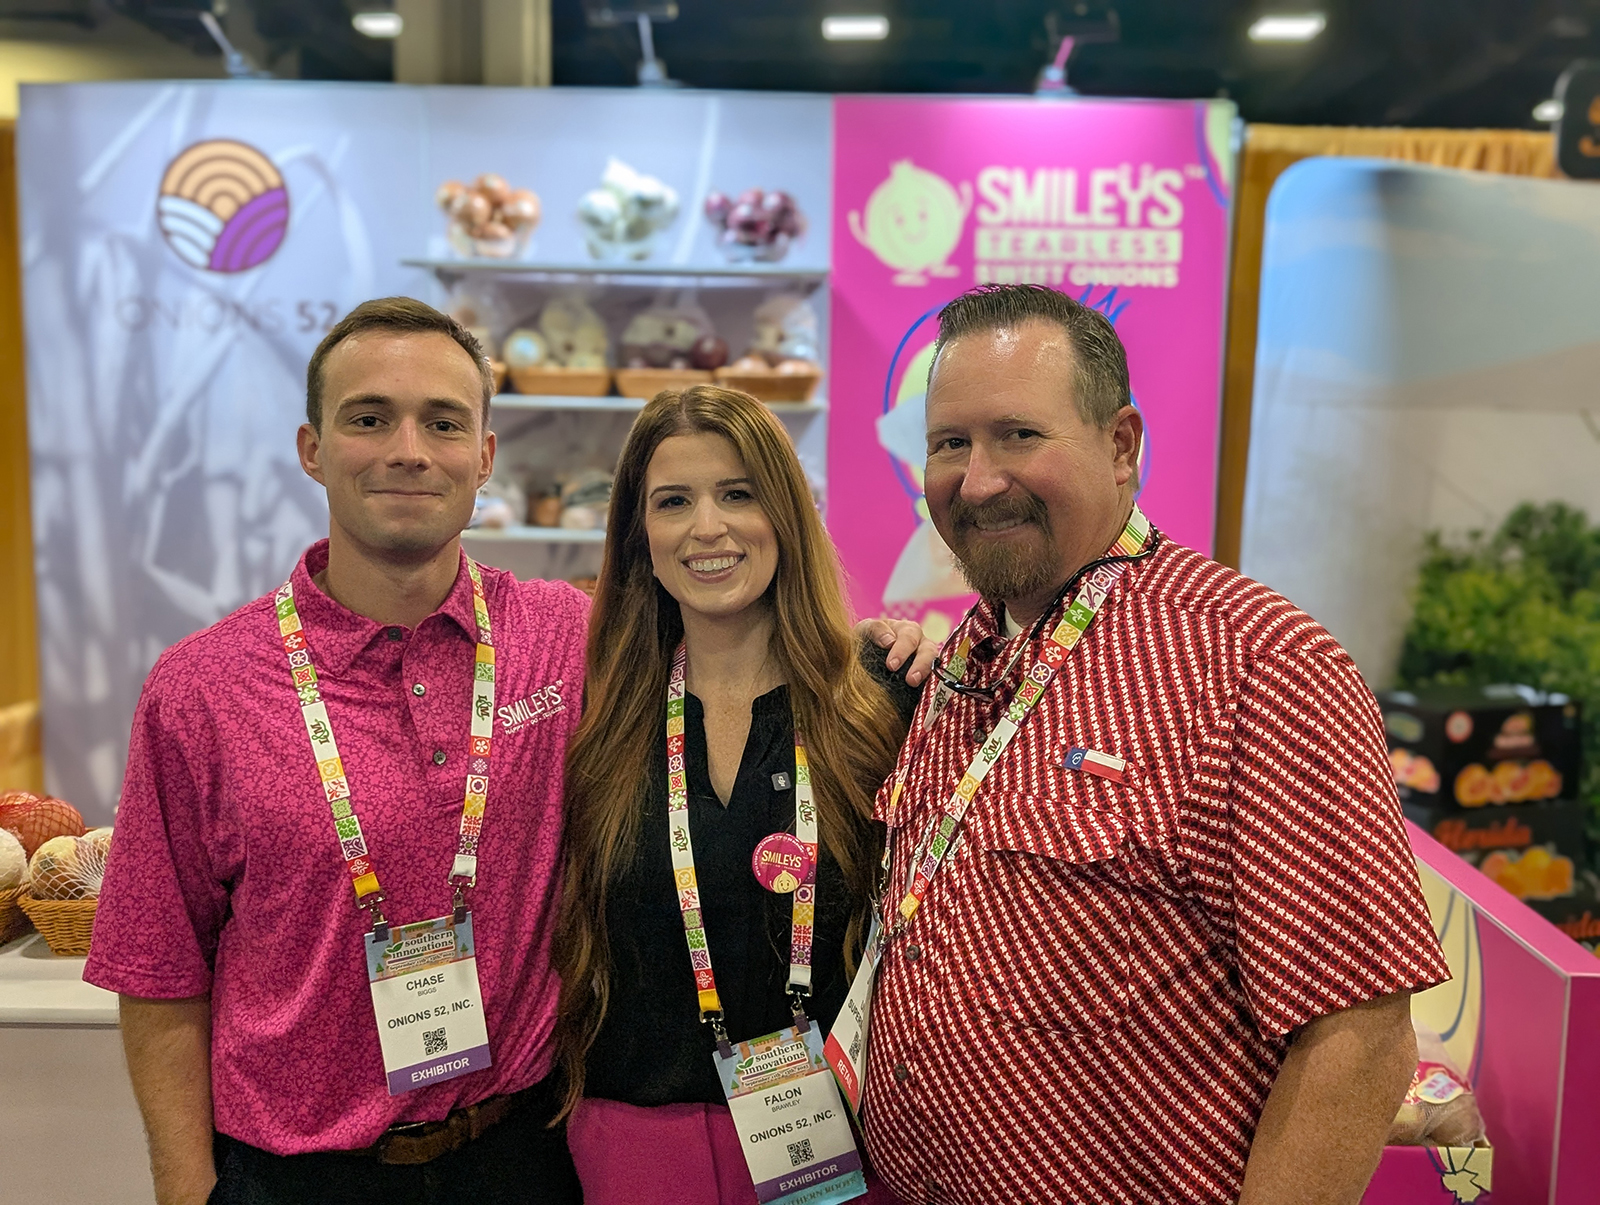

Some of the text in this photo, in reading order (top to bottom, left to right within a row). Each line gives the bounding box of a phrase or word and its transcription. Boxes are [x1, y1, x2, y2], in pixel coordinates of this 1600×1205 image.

[1069, 265, 1178, 287] ONIONS
[297, 301, 337, 333] 52
[392, 939, 454, 959] innovations
[405, 931, 453, 947] southern
[406, 974, 445, 991] CHASE
[418, 987, 437, 997] BIGGS
[388, 999, 474, 1029] ONIONS 52, INC.
[745, 1051, 805, 1074] innovations
[756, 1042, 803, 1062] southern
[411, 1058, 469, 1082] EXHIBITOR
[837, 1059, 853, 1089] RETAIL
[764, 1087, 802, 1106] FALON
[772, 1099, 800, 1112] BRAWLEY
[750, 1110, 836, 1144] ONIONS 52, INC.
[779, 1164, 838, 1191] EXHIBITOR
